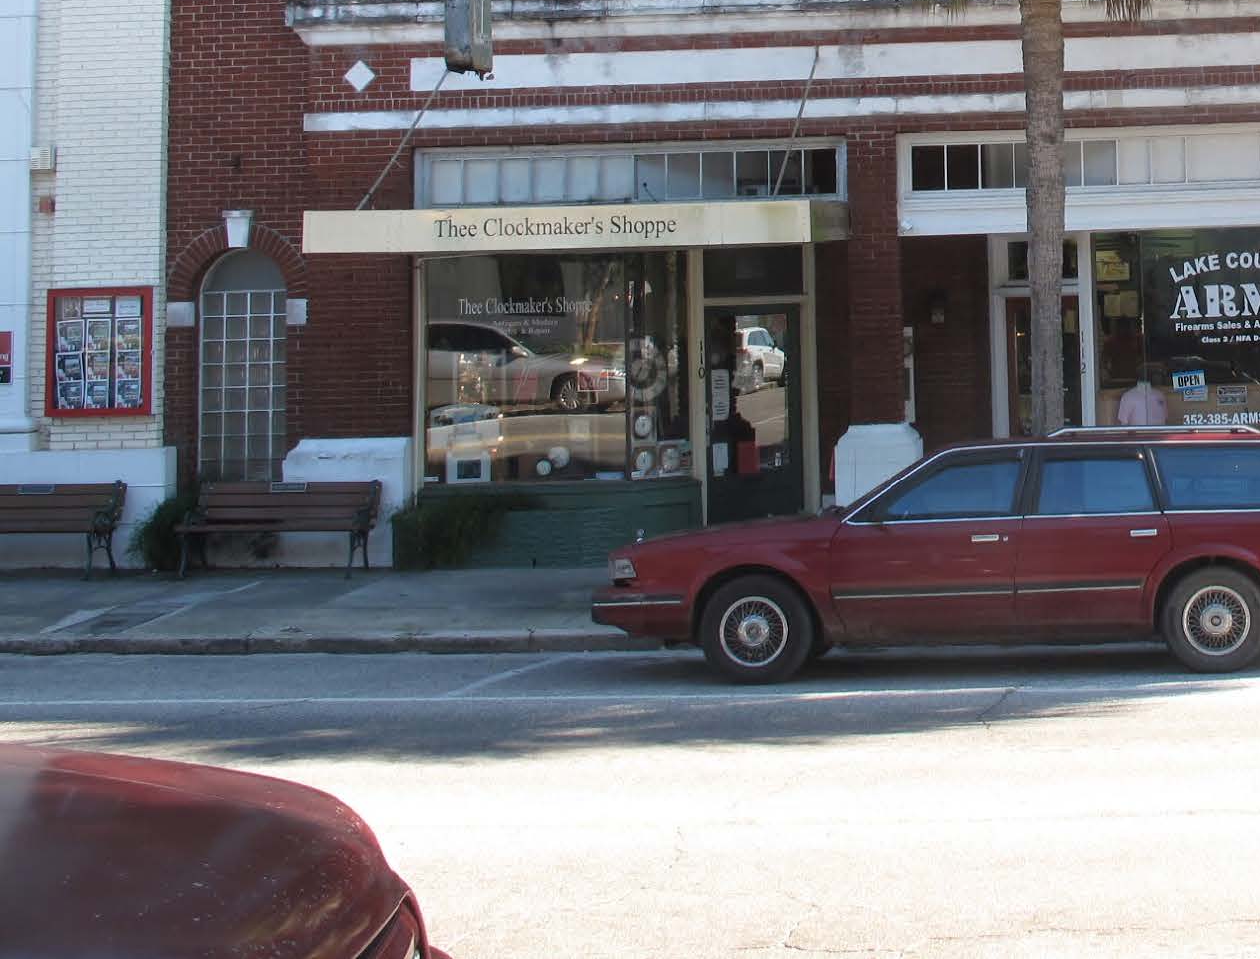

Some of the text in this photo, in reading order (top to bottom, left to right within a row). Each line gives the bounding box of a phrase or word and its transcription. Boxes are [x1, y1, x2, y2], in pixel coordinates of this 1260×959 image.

[434, 215, 677, 239] Thee Clockmaker's Shoppe
[1169, 254, 1221, 283] LAKE
[458, 298, 482, 315] Thee
[485, 297, 553, 315] Clockmaker's
[1175, 322, 1214, 332] Firearms
[1217, 320, 1241, 330] Sales
[1244, 320, 1251, 329] &
[1177, 374, 1201, 388] OPEN
